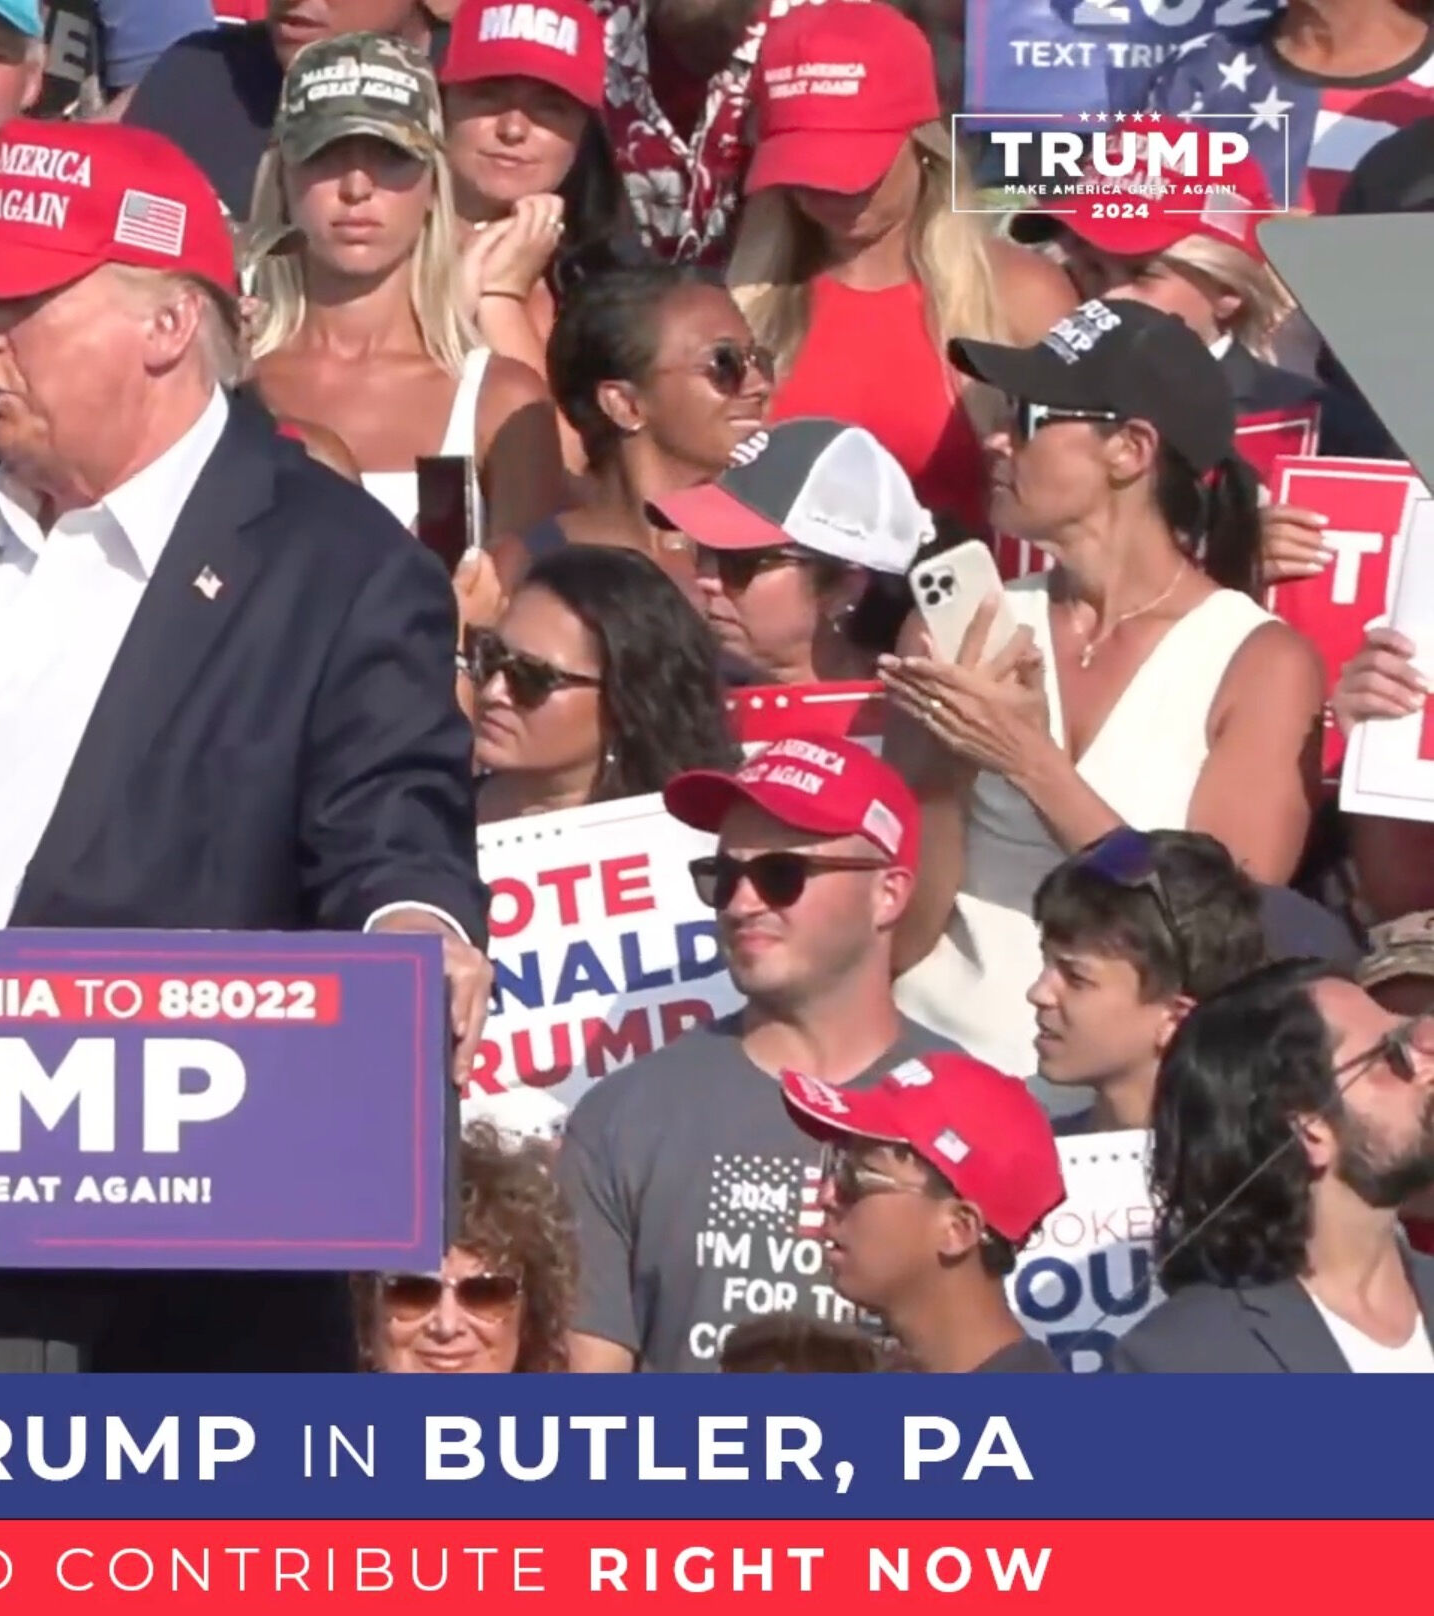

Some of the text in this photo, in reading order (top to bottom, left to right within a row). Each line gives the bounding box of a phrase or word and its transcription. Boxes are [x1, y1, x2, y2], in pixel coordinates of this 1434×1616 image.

[477, 2, 578, 56] MAGA
[1009, 40, 1096, 67] TEXT
[796, 62, 867, 79] AMERICA
[307, 79, 411, 106] GREAT AGAIN
[810, 79, 860, 96] AGAIN
[765, 763, 826, 796] AGAIN
[75, 979, 143, 1018] TO
[159, 980, 316, 1019] 88022
[74, 1176, 212, 1205] AGAIN!
[728, 1179, 789, 1213] 2024
[696, 1230, 752, 1270] I'M
[723, 1276, 798, 1315] FOR
